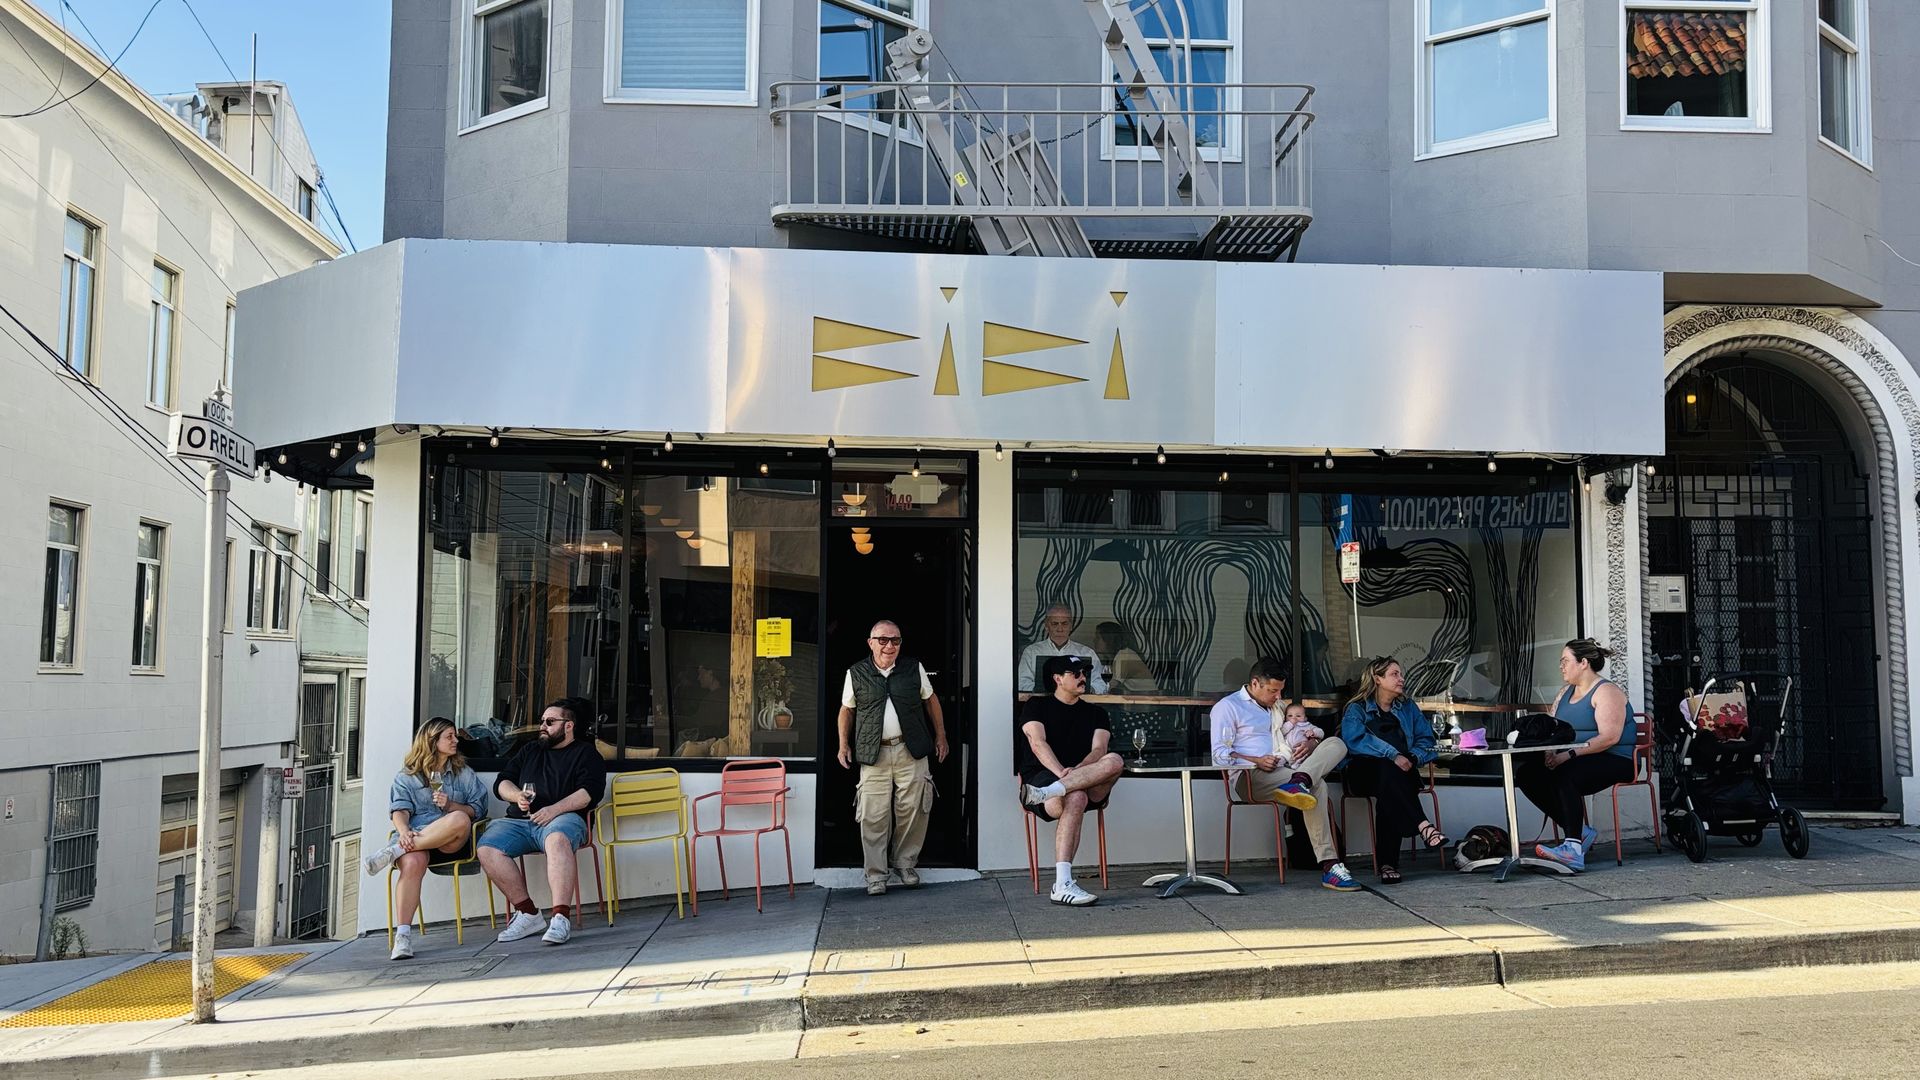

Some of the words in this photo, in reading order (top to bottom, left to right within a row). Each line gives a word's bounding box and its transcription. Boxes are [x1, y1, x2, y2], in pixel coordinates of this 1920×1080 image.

[211, 403, 225, 421] 000
[178, 424, 249, 468] ORRELL
[885, 494, 913, 511] 1448
